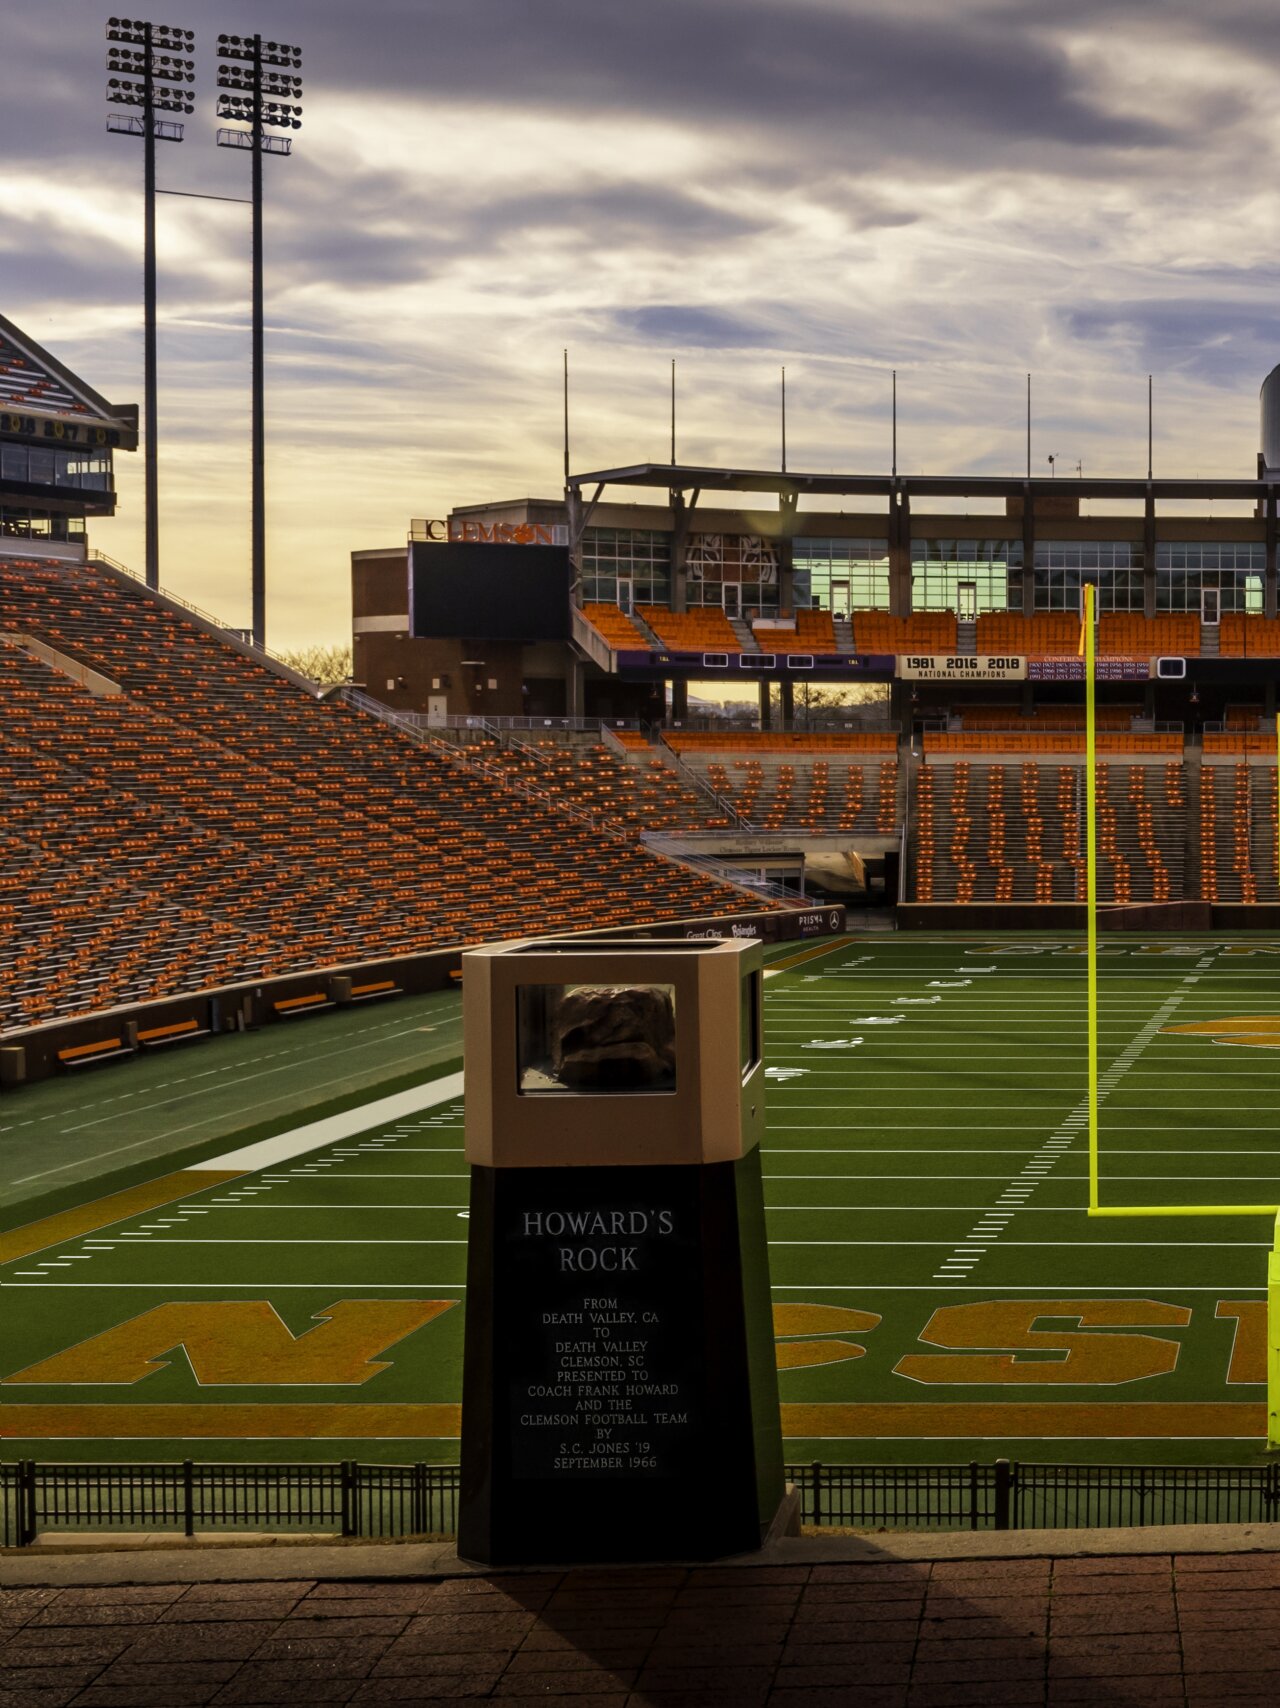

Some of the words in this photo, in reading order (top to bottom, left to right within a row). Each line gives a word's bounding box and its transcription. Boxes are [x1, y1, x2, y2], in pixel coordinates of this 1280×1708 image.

[906, 657, 935, 669] 1981
[946, 657, 978, 669] 2016
[987, 658, 1020, 669] 2018
[918, 670, 956, 678] NATIONAL
[960, 670, 1006, 678] CHAMPIONS
[798, 915, 823, 926] PRISMA
[731, 923, 757, 938] Bojangles
[522, 1210, 674, 1236] HOWARD'S
[558, 1247, 640, 1271] ROCK
[583, 1298, 618, 1309] FROM
[542, 1313, 583, 1324] DEATH
[642, 1312, 660, 1323] CA
[593, 1327, 610, 1338] TO
[555, 1342, 596, 1353] DEATH
[603, 1341, 649, 1352] VALLEY
[628, 1355, 645, 1367] SC
[557, 1370, 626, 1382] PRESENTED
[632, 1370, 649, 1381] TO
[527, 1385, 572, 1397] COACH
[578, 1385, 620, 1396] FRANK
[626, 1384, 679, 1396] HOWARD
[575, 1400, 602, 1411] AND
[607, 1399, 633, 1410] THE
[520, 1414, 579, 1426] CLEMSON
[585, 1413, 648, 1425] FOOTBALL
[653, 1413, 688, 1424] TEAM
[596, 1428, 612, 1439] BY
[588, 1442, 630, 1454] JONES
[635, 1442, 651, 1454] '19
[554, 1457, 623, 1469] SEPTEMBER
[629, 1456, 657, 1468] 1966
